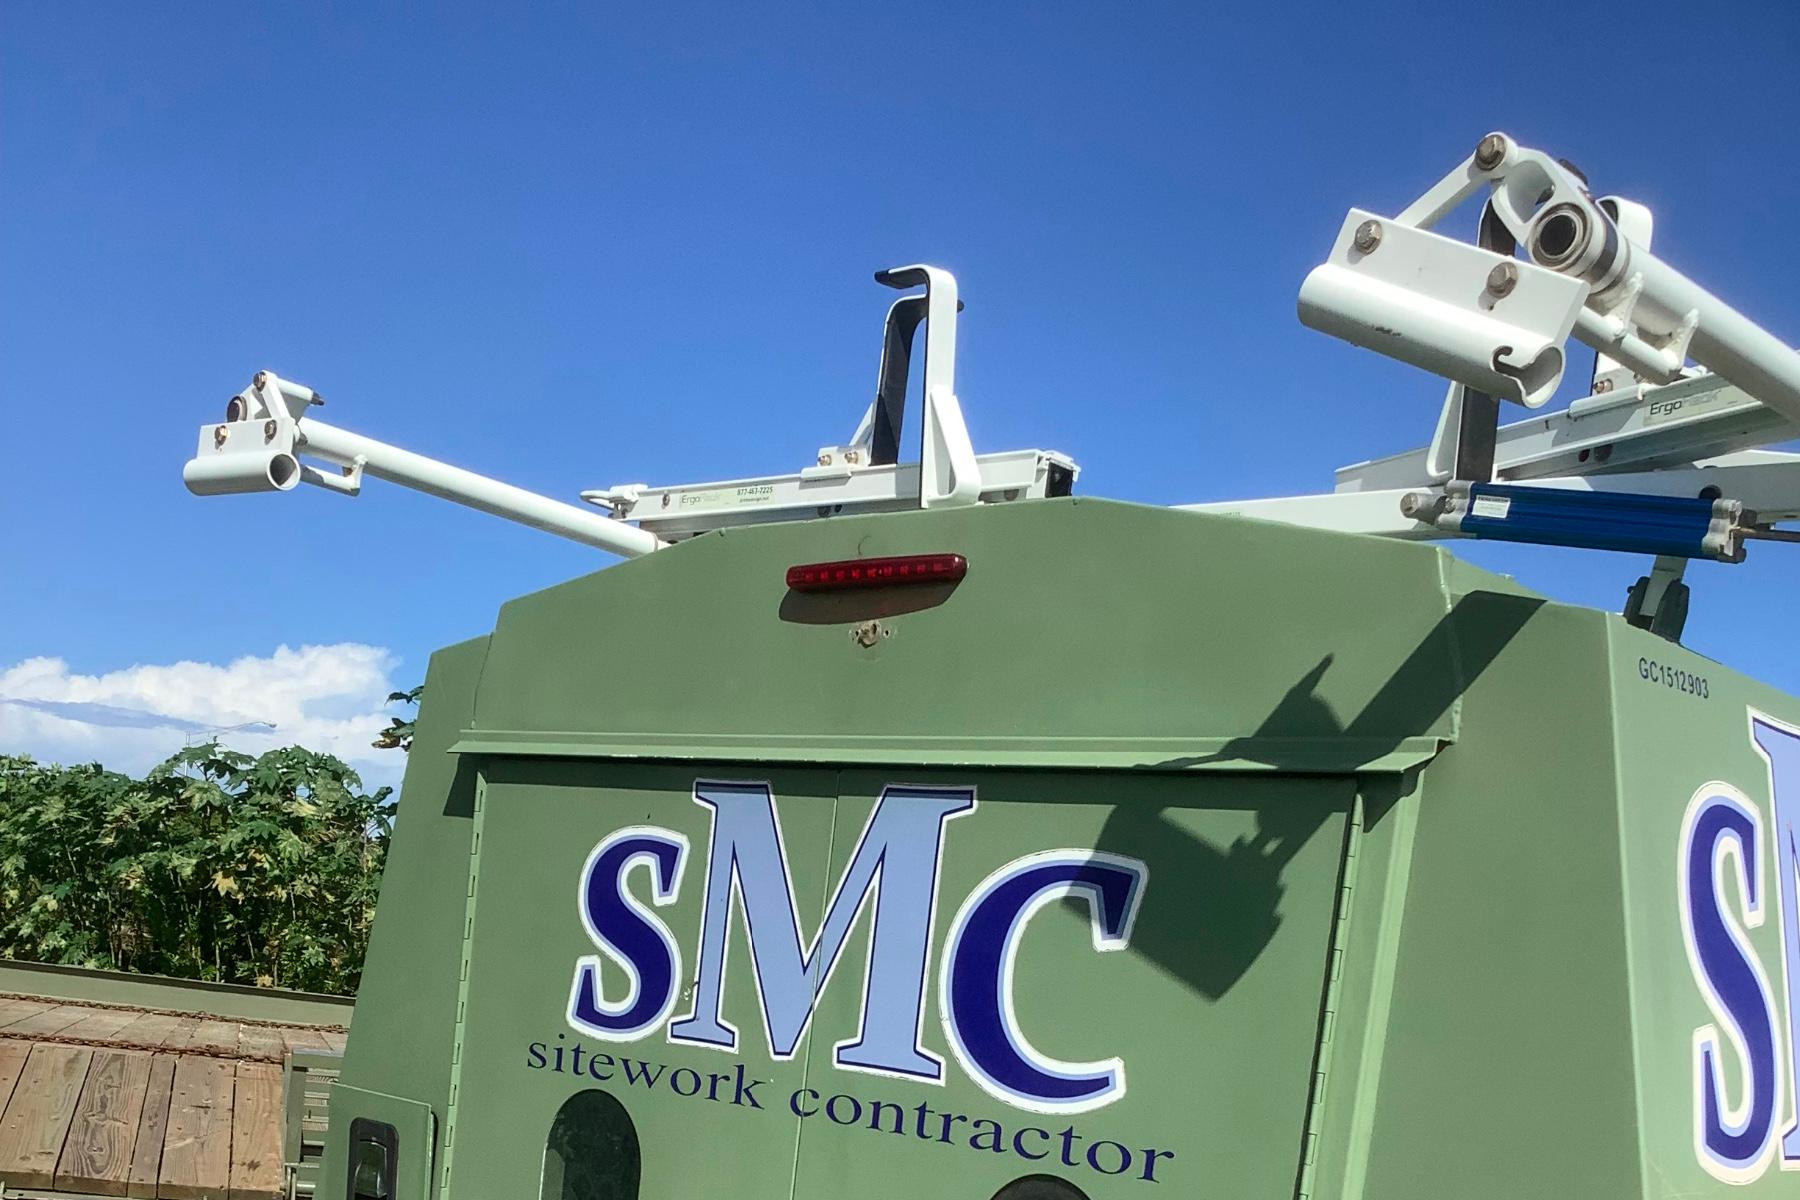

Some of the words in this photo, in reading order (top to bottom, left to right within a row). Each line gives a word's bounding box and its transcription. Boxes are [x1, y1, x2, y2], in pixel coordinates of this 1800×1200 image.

[1638, 656, 1710, 700] GC1512903
[566, 777, 1149, 1114] SMC
[527, 1033, 765, 1110] sitework
[789, 1086, 1175, 1184] contractor
